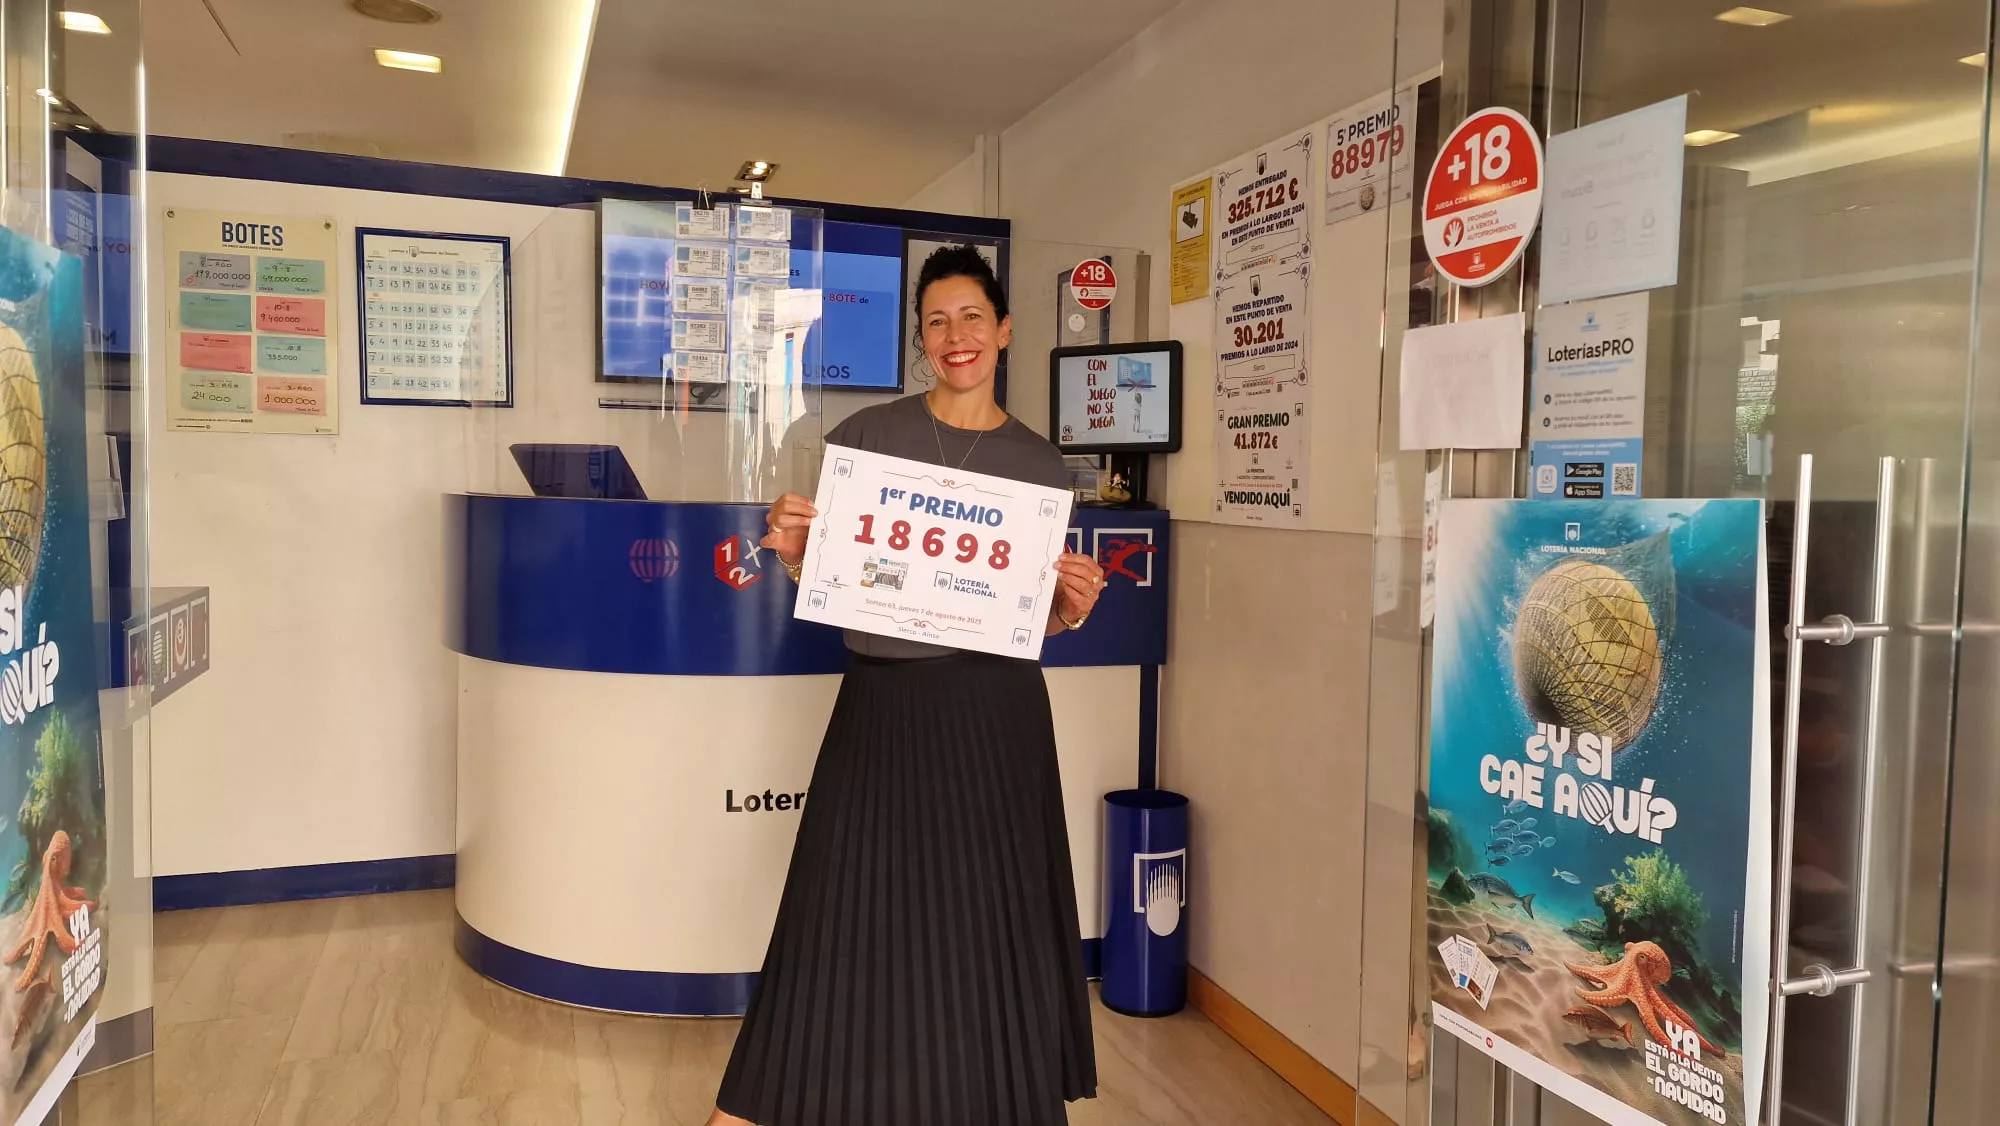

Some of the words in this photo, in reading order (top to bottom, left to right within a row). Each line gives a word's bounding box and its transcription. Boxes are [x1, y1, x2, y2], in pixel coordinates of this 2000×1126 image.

[1348, 104, 1400, 142] PREMIO
[1331, 124, 1404, 180] 88979
[1447, 124, 1511, 186] +18
[1255, 169, 1288, 191] ENTREGADO
[1228, 183, 1284, 224] 325.712
[1288, 178, 1299, 201] €
[1434, 200, 1454, 211] JUEGA
[1253, 218, 1261, 228] LO
[1261, 211, 1282, 226] LARGO
[1283, 206, 1291, 217] DE
[1291, 202, 1305, 215] 2024
[1467, 224, 1475, 232] LA
[1475, 219, 1494, 230] VENTA
[1494, 218, 1500, 226] A
[221, 221, 284, 247] BOTES
[1248, 227, 1265, 241] PUNTO
[1266, 223, 1275, 233] DE
[1275, 217, 1294, 230] VENTA
[1466, 222, 1517, 240] AUTOPROHIBIDOS
[1080, 265, 1106, 281] +18
[829, 292, 857, 304] BOTE
[1232, 302, 1252, 313] HEMOS
[1252, 294, 1285, 310] REPARTIDO
[1226, 316, 1233, 325] EN
[1233, 314, 1246, 324] ESTE
[1247, 309, 1266, 321] PUNTO
[1266, 307, 1275, 317] DE
[1275, 303, 1293, 315] VENTA
[1234, 317, 1285, 348] 30.201
[1220, 349, 1245, 362] PREMIOS
[1250, 348, 1258, 358] LO
[1258, 344, 1276, 356] LARGO
[1276, 342, 1284, 352] DE
[1284, 340, 1299, 351] 2024
[1087, 358, 1107, 371] CON
[1087, 373, 1097, 387] EL
[1087, 388, 1117, 401] JUEGO
[1087, 402, 1101, 416] NO
[1105, 401, 1115, 414] SE
[1087, 415, 1116, 431] JUEGA
[1227, 413, 1252, 430] GRAN
[1252, 411, 1290, 429] PREMIO
[1233, 431, 1271, 450] 41.872
[1271, 434, 1279, 450] €
[1224, 490, 1263, 506] VENDIDO
[1263, 488, 1291, 509] AQUÍ
[1574, 488, 1586, 497] App
[1587, 488, 1602, 496] Store
[879, 486, 906, 507] 1er
[908, 492, 1004, 528] PREMIO
[853, 513, 1012, 571] 18698
[1541, 544, 1568, 554] LOTERÍA
[1569, 546, 1608, 556] NACIONAL
[953, 576, 990, 590] LOTERÍA
[953, 583, 999, 599] NACIONAL
[925, 608, 934, 616] de
[934, 612, 957, 622] agosto
[1526, 722, 1571, 769] ¿Y
[1577, 732, 1613, 781] SI
[726, 788, 808, 812] Loter
[1480, 753, 1546, 809] CAE
[1553, 772, 1678, 845] AQUÍ?
[69, 903, 90, 947] YA
[1665, 1018, 1701, 1062] YA
[1644, 1038, 1669, 1060] ESTÁ
[1669, 1050, 1677, 1063] A
[1677, 1055, 1692, 1069] LA
[1691, 1060, 1725, 1086] VENTA
[1645, 1050, 1666, 1078] EL
[1667, 1063, 1725, 1104] GORDO
[1654, 1076, 1727, 1126] NAVIDAD
